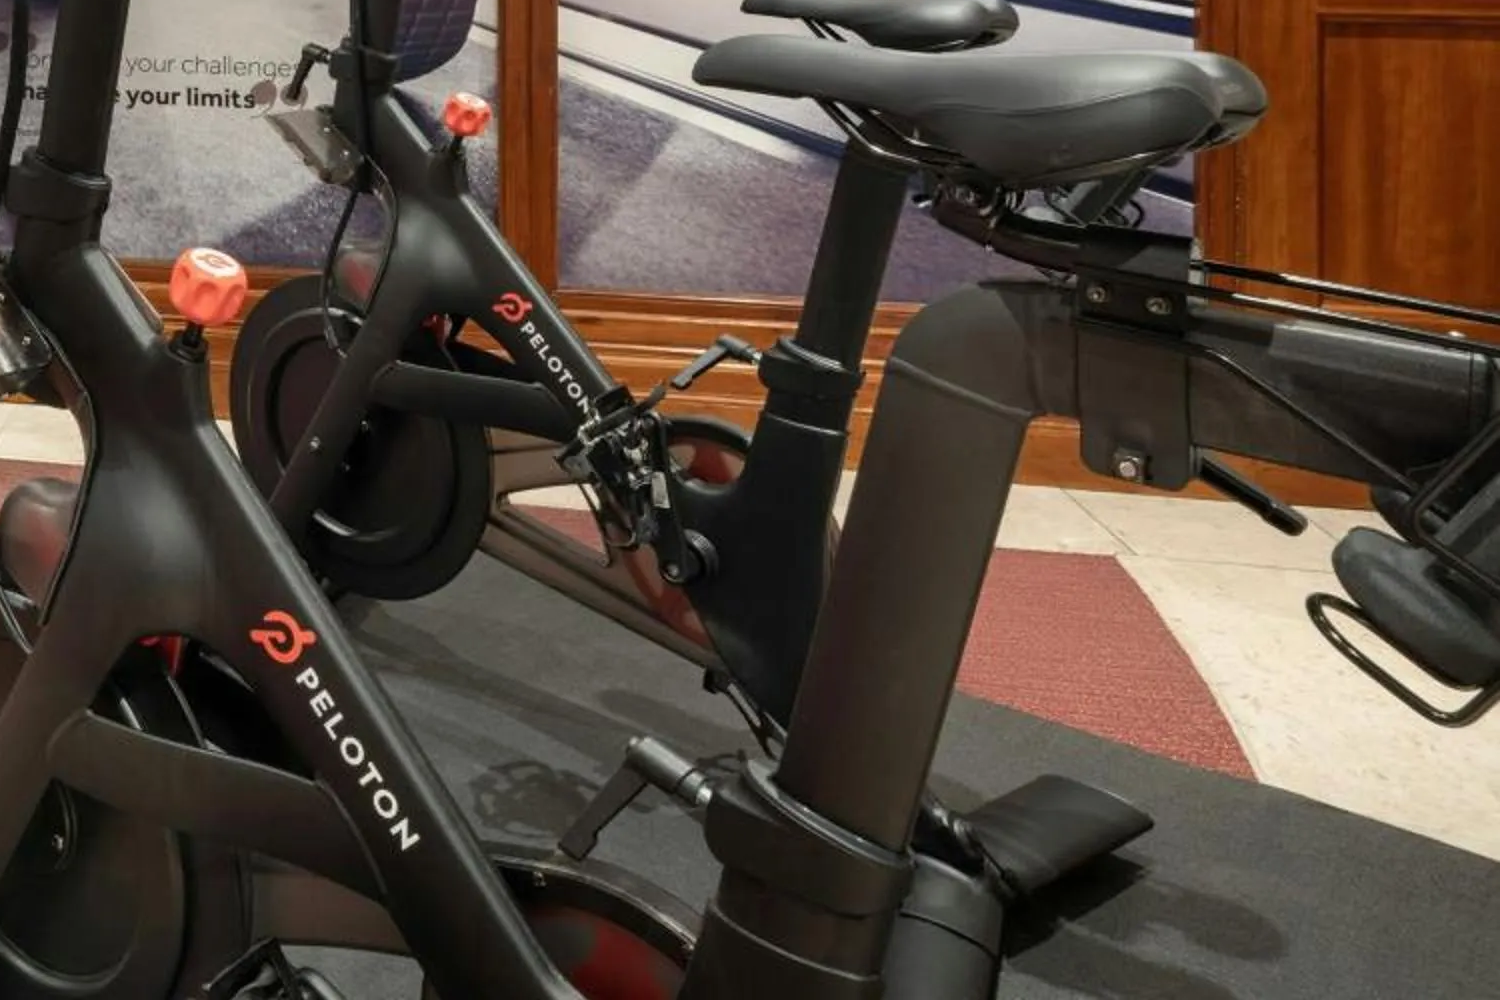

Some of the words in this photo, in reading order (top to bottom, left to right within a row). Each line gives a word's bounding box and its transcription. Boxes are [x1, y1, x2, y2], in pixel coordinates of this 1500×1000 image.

[126, 56, 177, 77] your
[125, 88, 181, 110] your
[186, 87, 256, 109] limits
[519, 320, 591, 415] PELOTON
[296, 666, 421, 851] PELOTON
